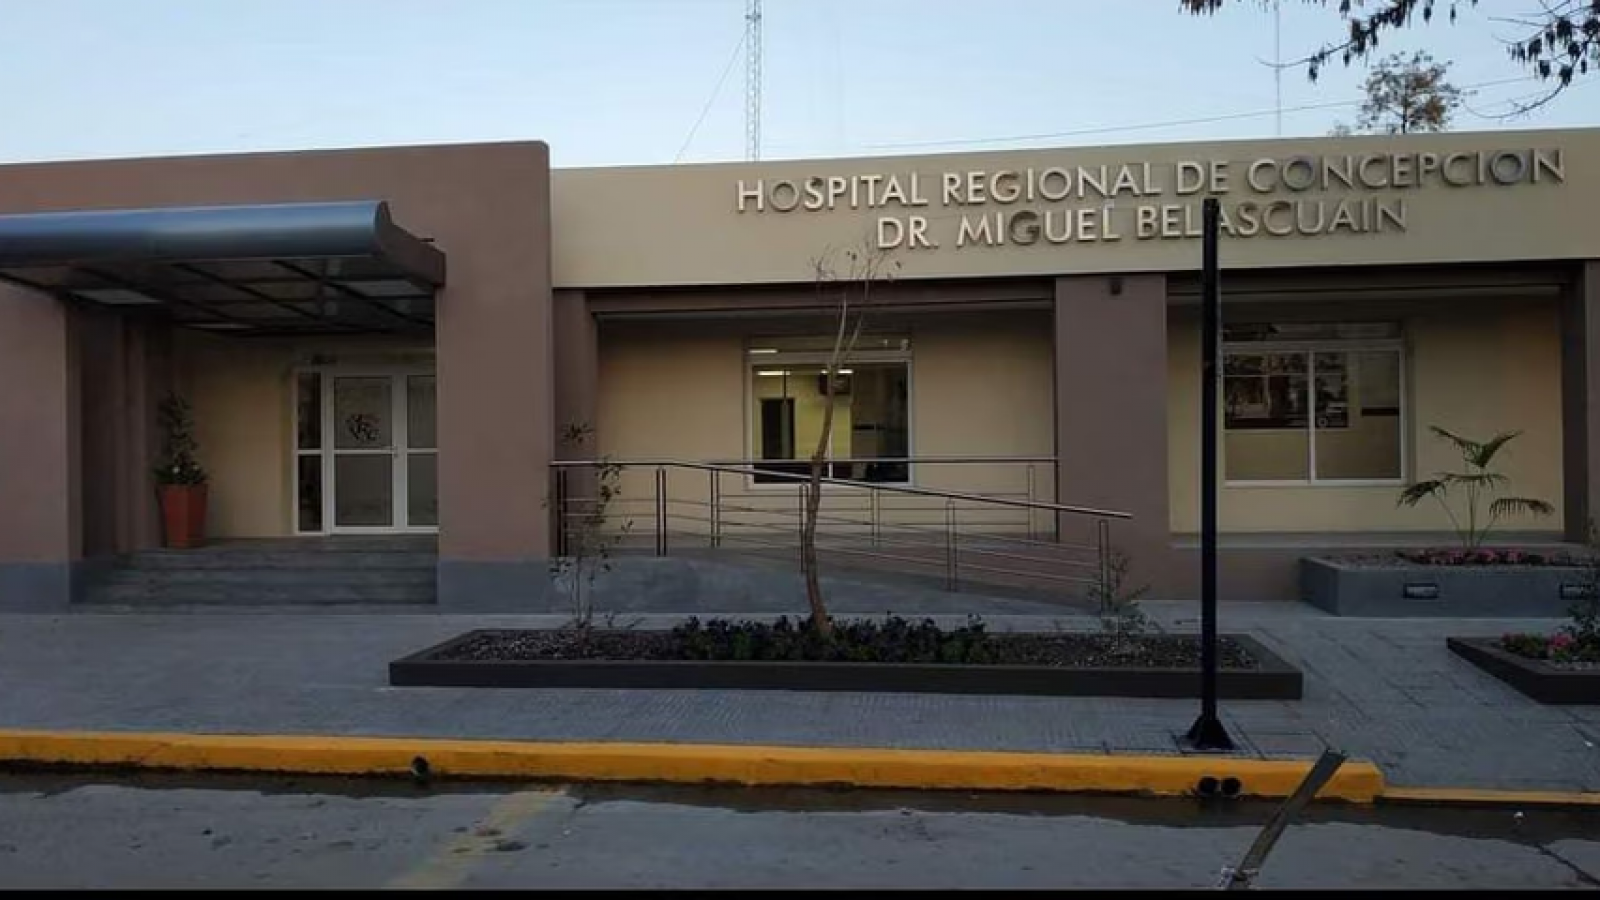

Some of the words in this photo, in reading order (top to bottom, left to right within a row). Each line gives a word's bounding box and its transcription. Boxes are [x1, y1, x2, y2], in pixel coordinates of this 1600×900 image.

[736, 173, 928, 212] HOSPITAL
[942, 163, 1161, 203] REGIONAL
[1175, 160, 1229, 194] DE
[1246, 149, 1566, 193] CONCEPCION
[877, 217, 938, 249] DR.
[956, 207, 1121, 246] MIGUEL
